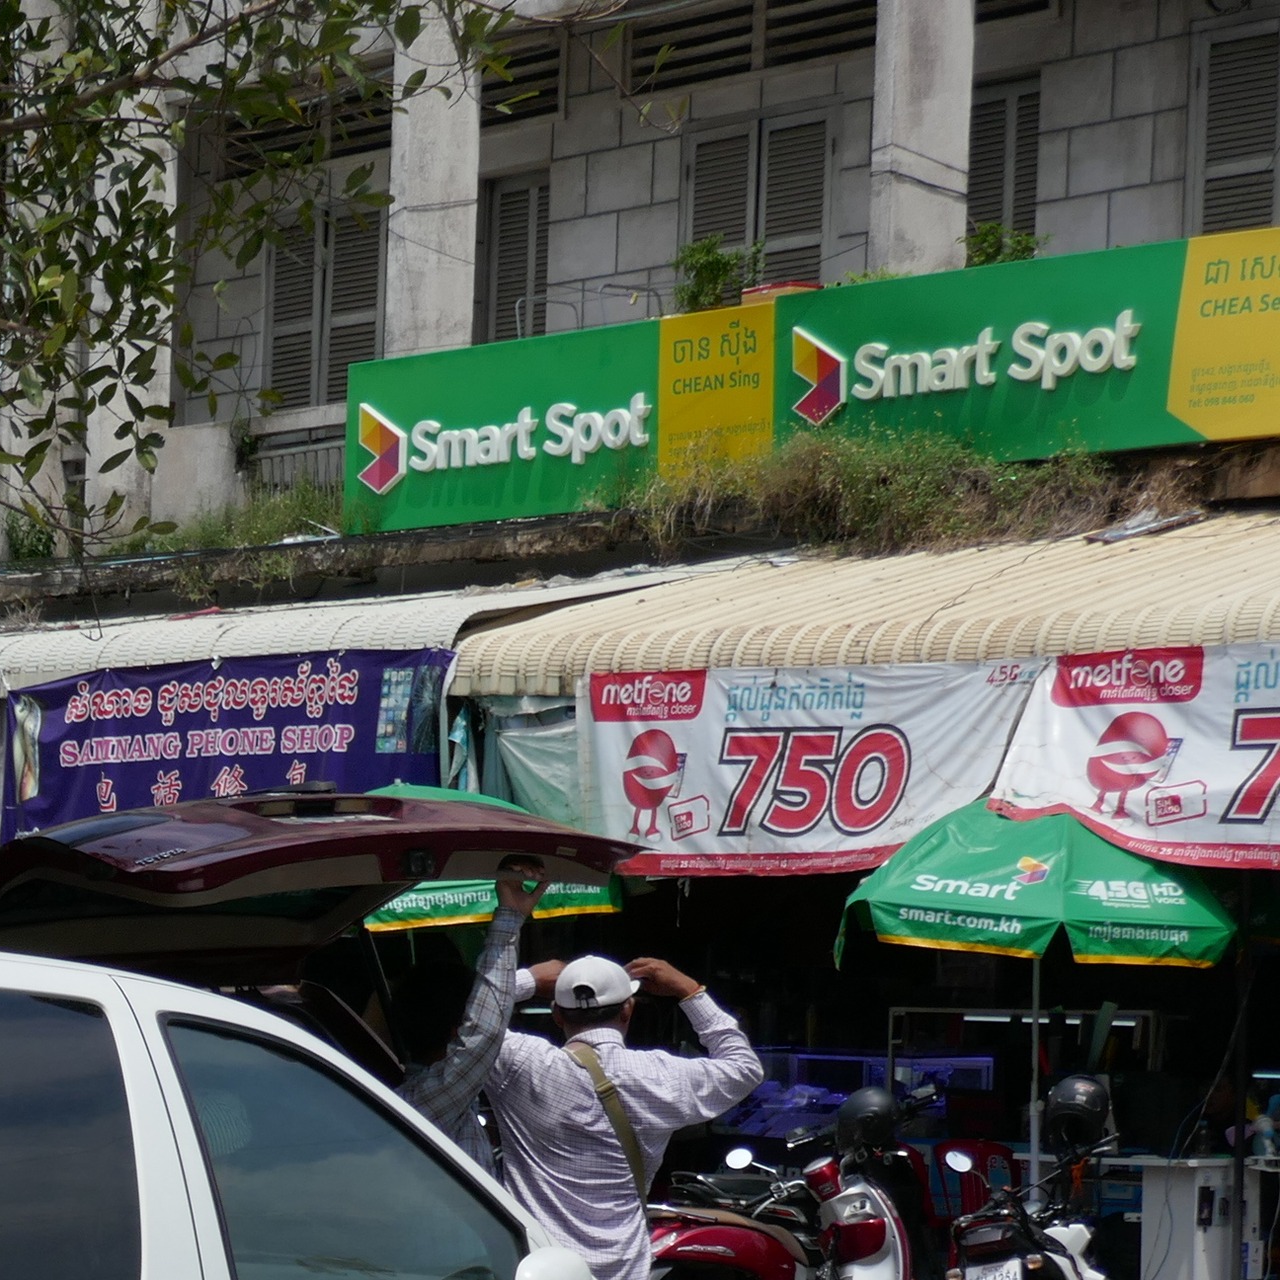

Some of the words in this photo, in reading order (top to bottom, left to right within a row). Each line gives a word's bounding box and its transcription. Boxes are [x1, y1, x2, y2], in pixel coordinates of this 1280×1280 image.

[1200, 297, 1253, 318] CHEA
[850, 327, 1002, 400] Smart
[1007, 309, 1143, 391] Spot
[672, 373, 725, 396] CHEAN
[729, 370, 760, 390] Sing
[409, 406, 539, 473] Smart
[542, 392, 652, 465] Spot
[1070, 655, 1186, 689] metfone
[601, 675, 692, 705] metfone
[1160, 684, 1194, 697] closer
[670, 702, 697, 715] closer
[60, 731, 181, 768] SAMNANG
[187, 726, 276, 760] PHONE
[281, 724, 355, 755] SHOP
[717, 723, 912, 837] 750
[1160, 846, 1173, 855] 25
[910, 874, 1022, 901] Smart
[1151, 883, 1184, 896] HD
[1155, 896, 1187, 905] VOICE
[899, 907, 1022, 935] smart.com.kh
